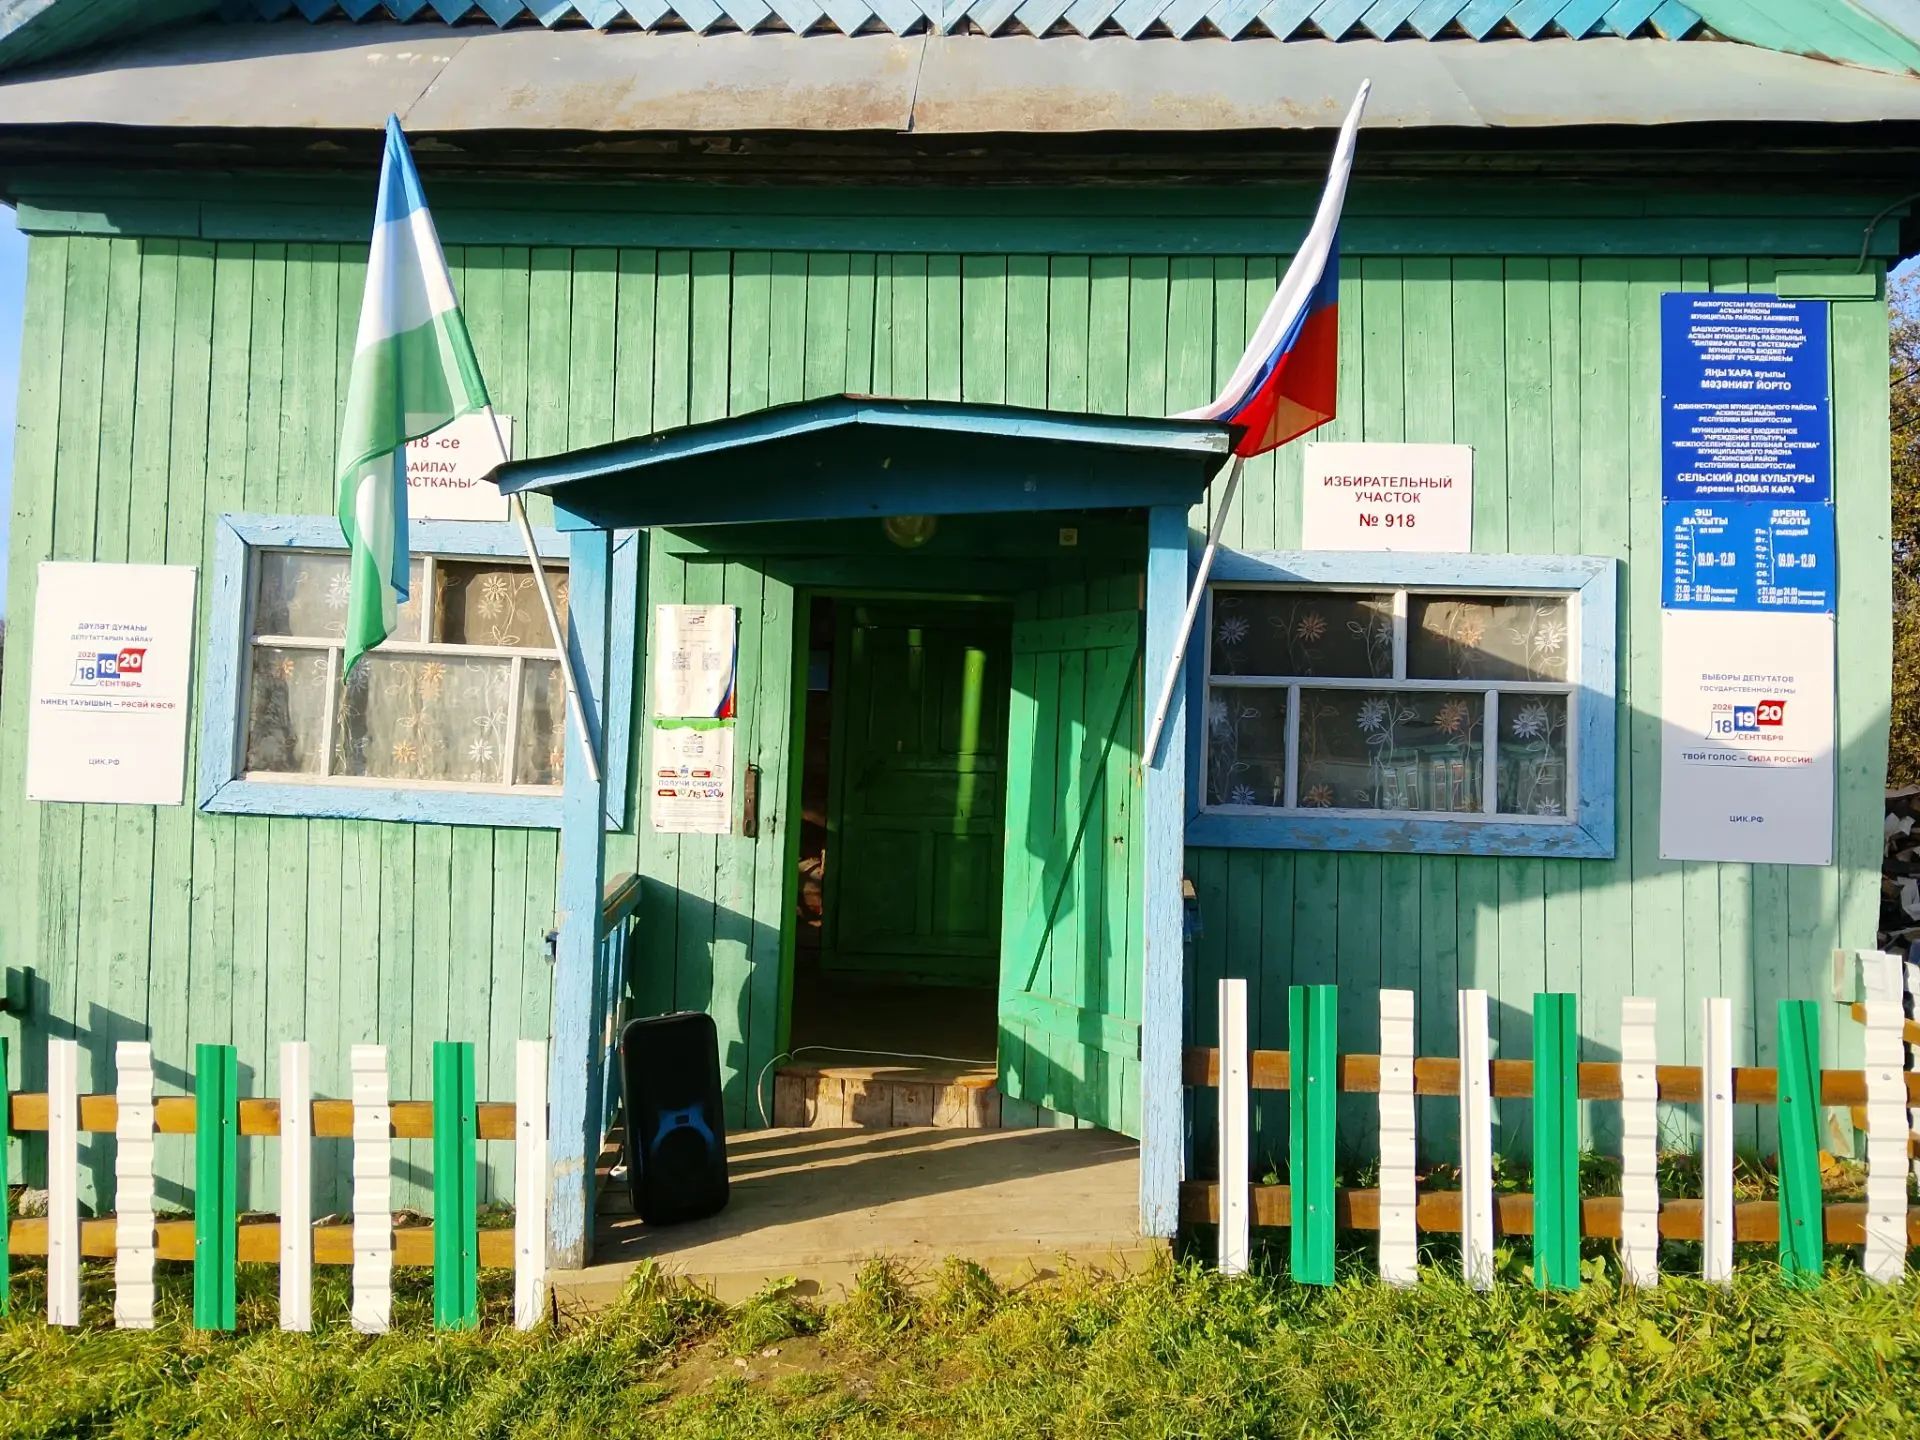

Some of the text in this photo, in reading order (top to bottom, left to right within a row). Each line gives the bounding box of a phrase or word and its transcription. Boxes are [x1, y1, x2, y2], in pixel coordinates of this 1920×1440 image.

[1704, 368, 1726, 378] ЯҢЫ
[1755, 371, 1786, 379] ауылы
[1757, 380, 1791, 390] ЙОРТО
[405, 436, 460, 448] 18 -се
[1324, 475, 1453, 488] ИЗБИРАТЕЛЬНЫЙ
[1677, 472, 1815, 483] СЕЛЬСКИЙ ДОМ КУЛЬТУРЫ
[1696, 485, 1795, 494] деревни НОВАЯ КАРА
[1355, 492, 1421, 503] УЧАСТОК
[1694, 509, 1712, 517] ЭШ
[1772, 509, 1806, 517] ВРЕМЯ
[1359, 513, 1415, 527] № 918
[1778, 553, 1795, 567] 09.00
[1801, 554, 1816, 568] 12.00
[112, 623, 147, 632] ДУМАҺЫ
[79, 653, 141, 680] 18 19 20
[1743, 674, 1794, 683] ДЕПУТАТОВ
[99, 680, 142, 688] СЕНТЯБРЬ
[1700, 685, 1772, 693] ГОСУДАРСТВЕННОЙ
[41, 699, 68, 708] ҺИНЕҢ
[70, 699, 112, 709] ТАУЫШЫҢ
[1714, 706, 1781, 734] 18 19 20
[1682, 752, 1706, 761] ТВОЙ
[1708, 753, 1737, 761] ГОЛОС
[1748, 755, 1772, 763] СИЛА
[692, 780, 723, 788] СКИДКУ
[1729, 815, 1764, 823] ЦИК.РФ
